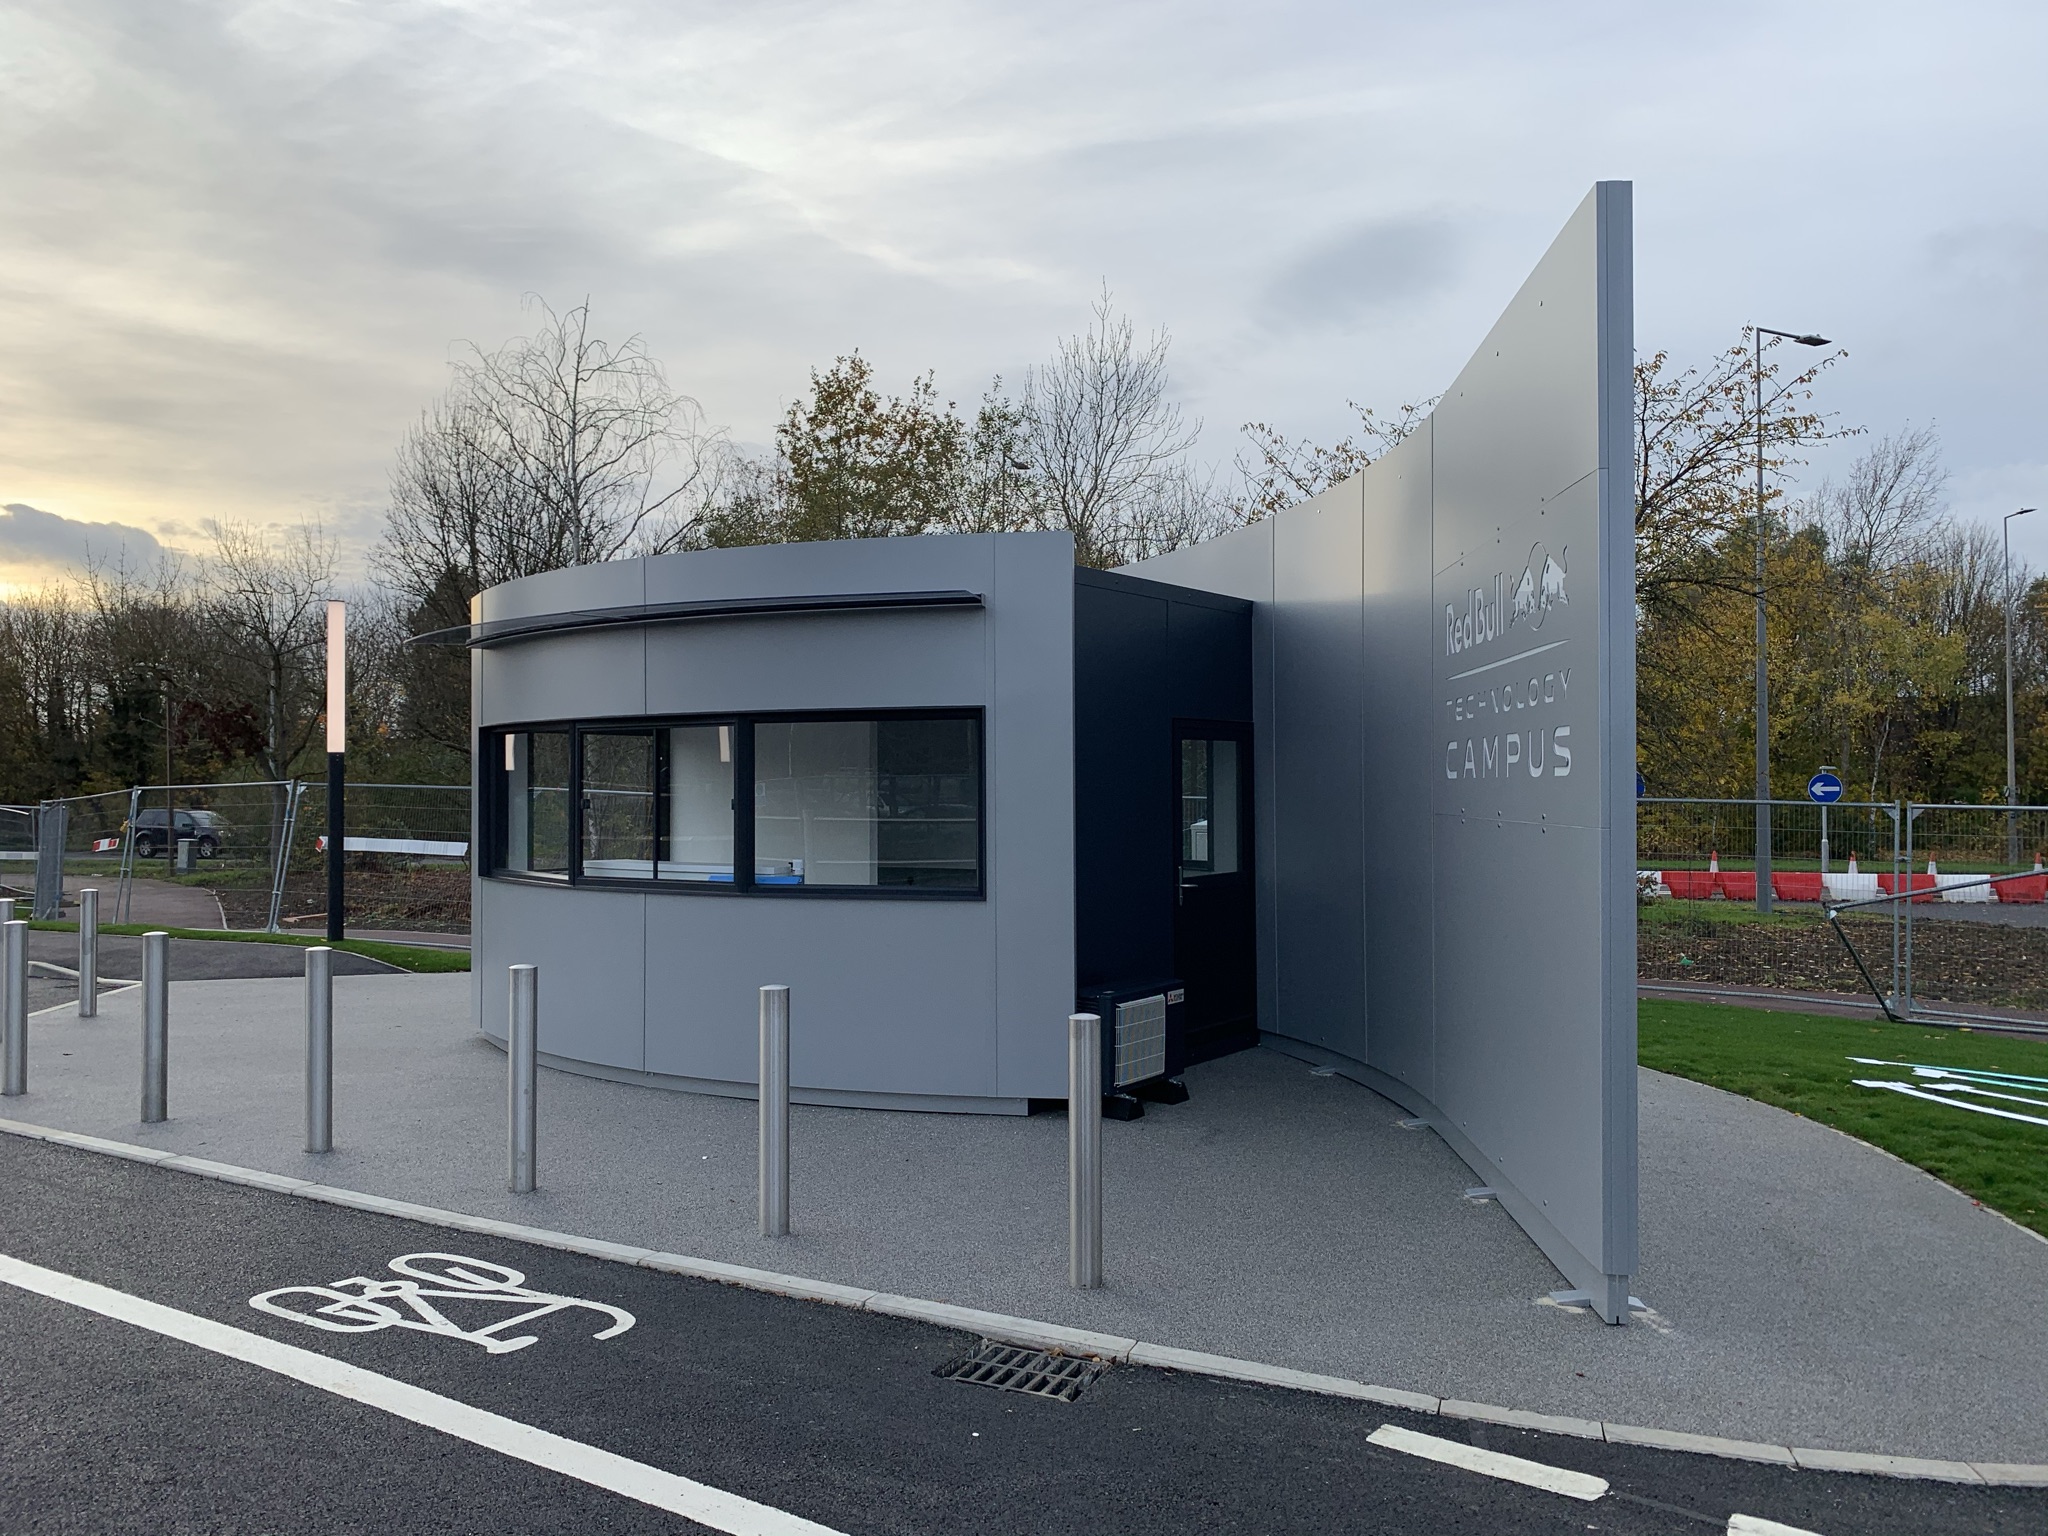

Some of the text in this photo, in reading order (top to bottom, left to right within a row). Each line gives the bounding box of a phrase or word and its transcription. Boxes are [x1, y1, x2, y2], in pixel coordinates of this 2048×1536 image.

[1446, 572, 1504, 656] Red Bull
[1446, 725, 1572, 779] CAMPUS
